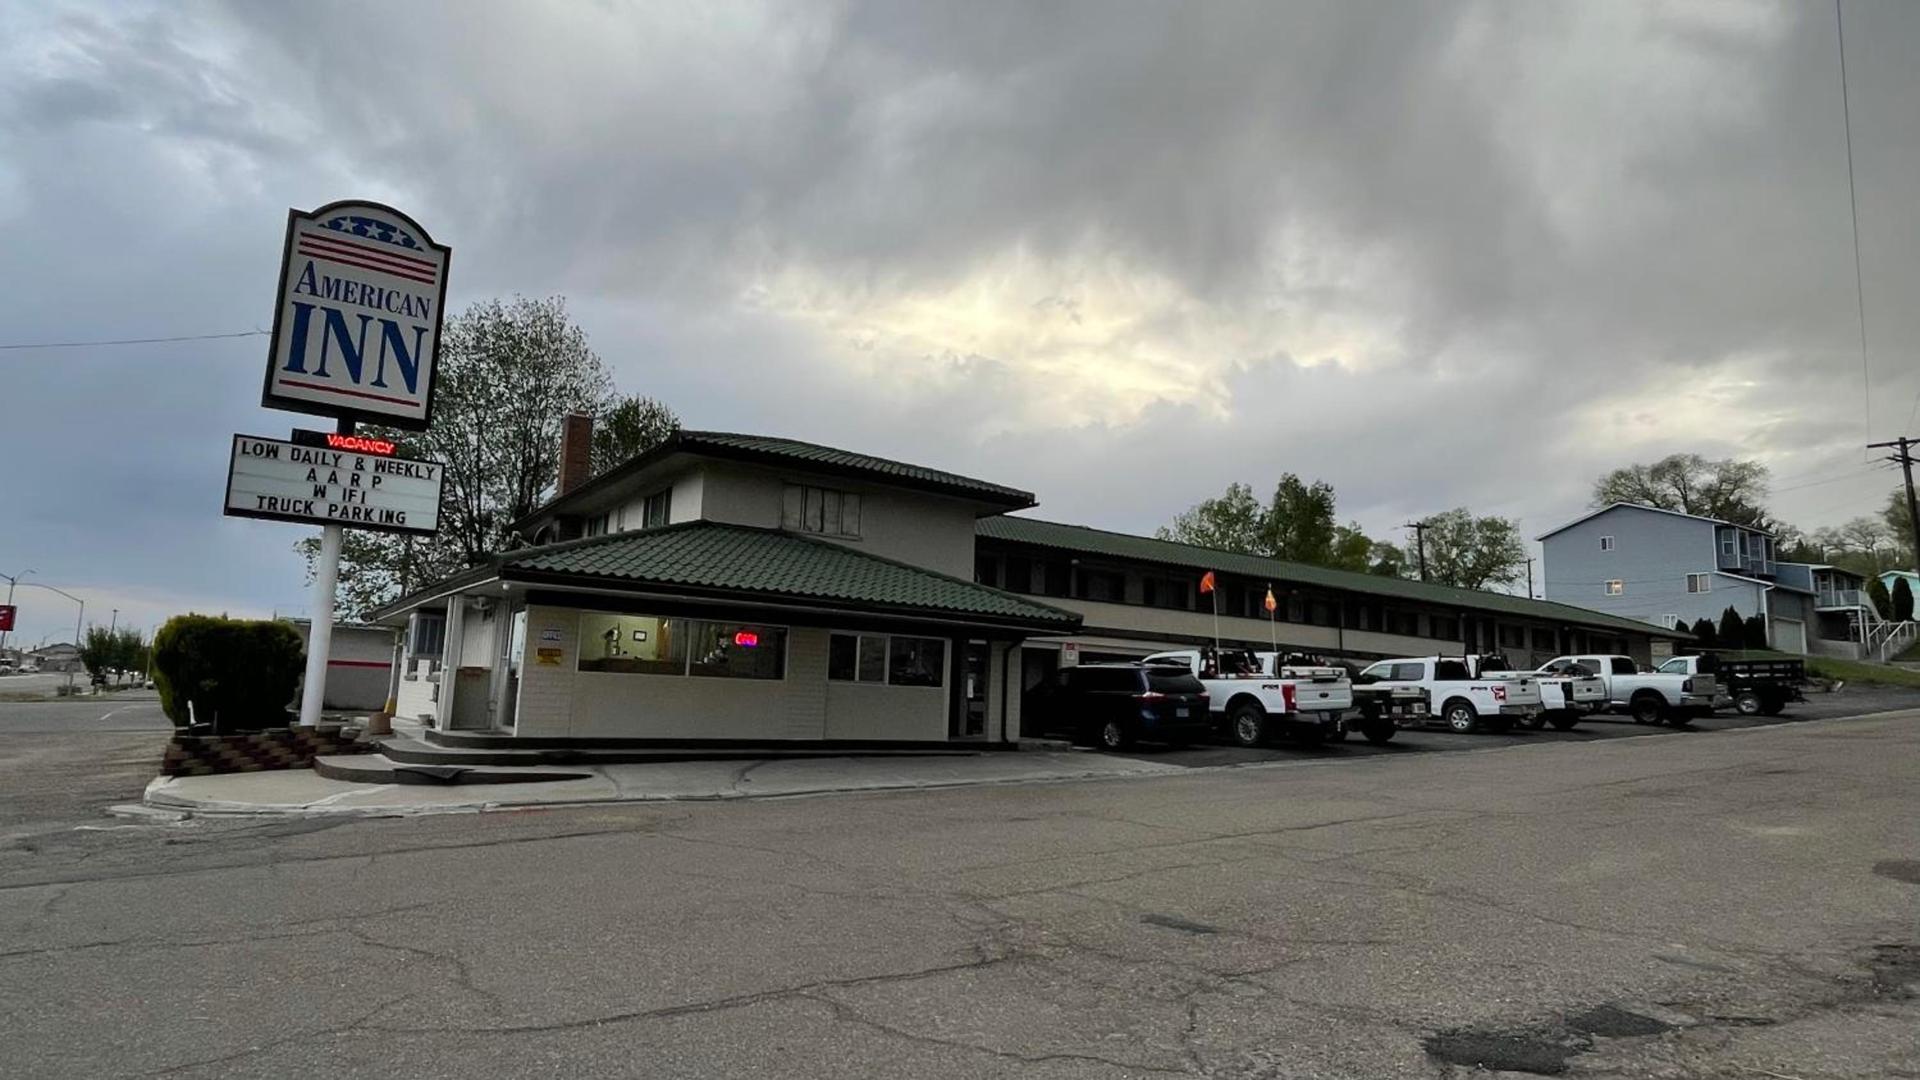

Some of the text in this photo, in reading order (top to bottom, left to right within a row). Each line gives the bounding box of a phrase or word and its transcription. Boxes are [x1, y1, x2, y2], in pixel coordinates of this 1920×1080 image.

[293, 260, 431, 321] AMERICAN
[282, 301, 429, 394] INN
[242, 441, 435, 480] LOW DAILY & WEEKLY
[327, 435, 395, 454] VACANCY
[257, 495, 406, 524] TRUCK PARKING
